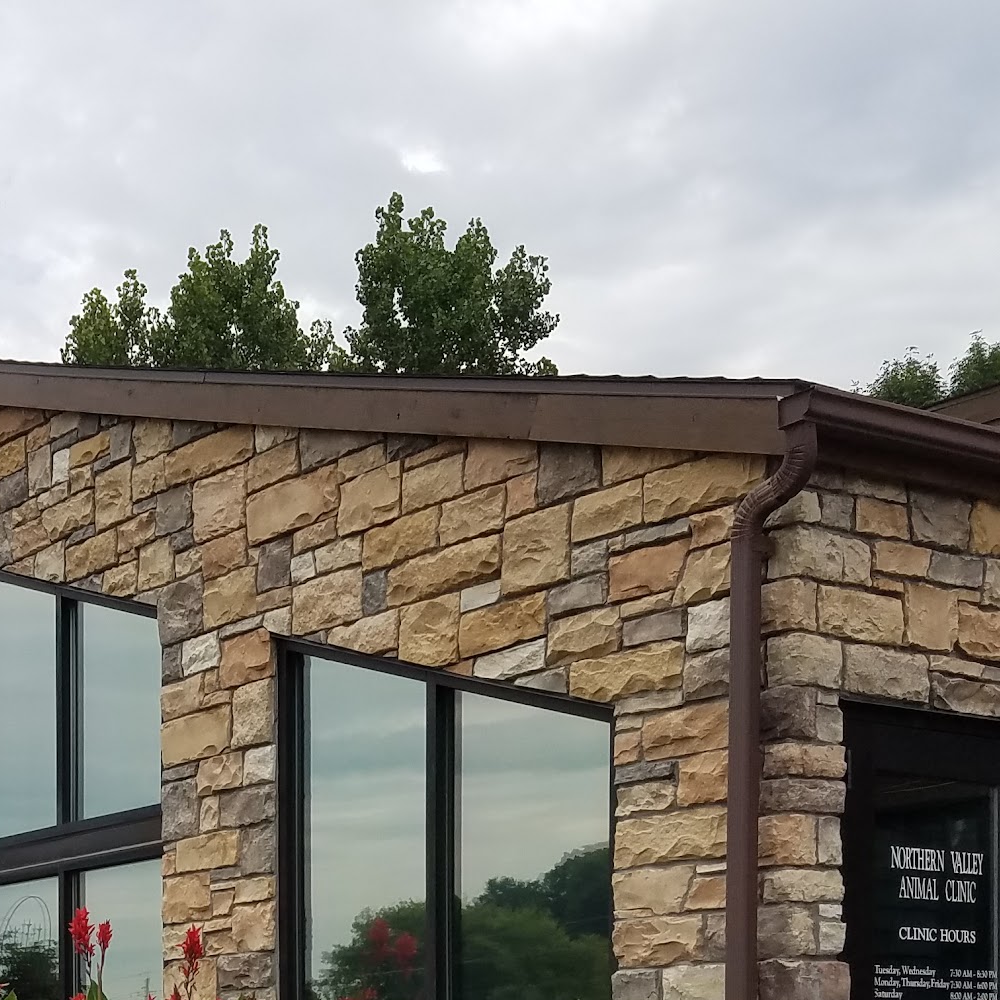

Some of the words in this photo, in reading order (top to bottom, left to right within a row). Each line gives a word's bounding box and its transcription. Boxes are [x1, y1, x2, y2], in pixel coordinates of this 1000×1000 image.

[890, 845, 945, 872] NORTHERN
[950, 850, 984, 875] VALLEY
[899, 875, 939, 901] ANIMAL
[945, 879, 977, 903] CLINIC
[898, 926, 938, 942] CLINIC
[940, 928, 976, 944] HOURS
[901, 965, 936, 977] Wednesday
[962, 969, 973, 978] AM
[962, 980, 973, 989] AM
[874, 988, 903, 1000] Saturday
[962, 992, 973, 1000] AM
